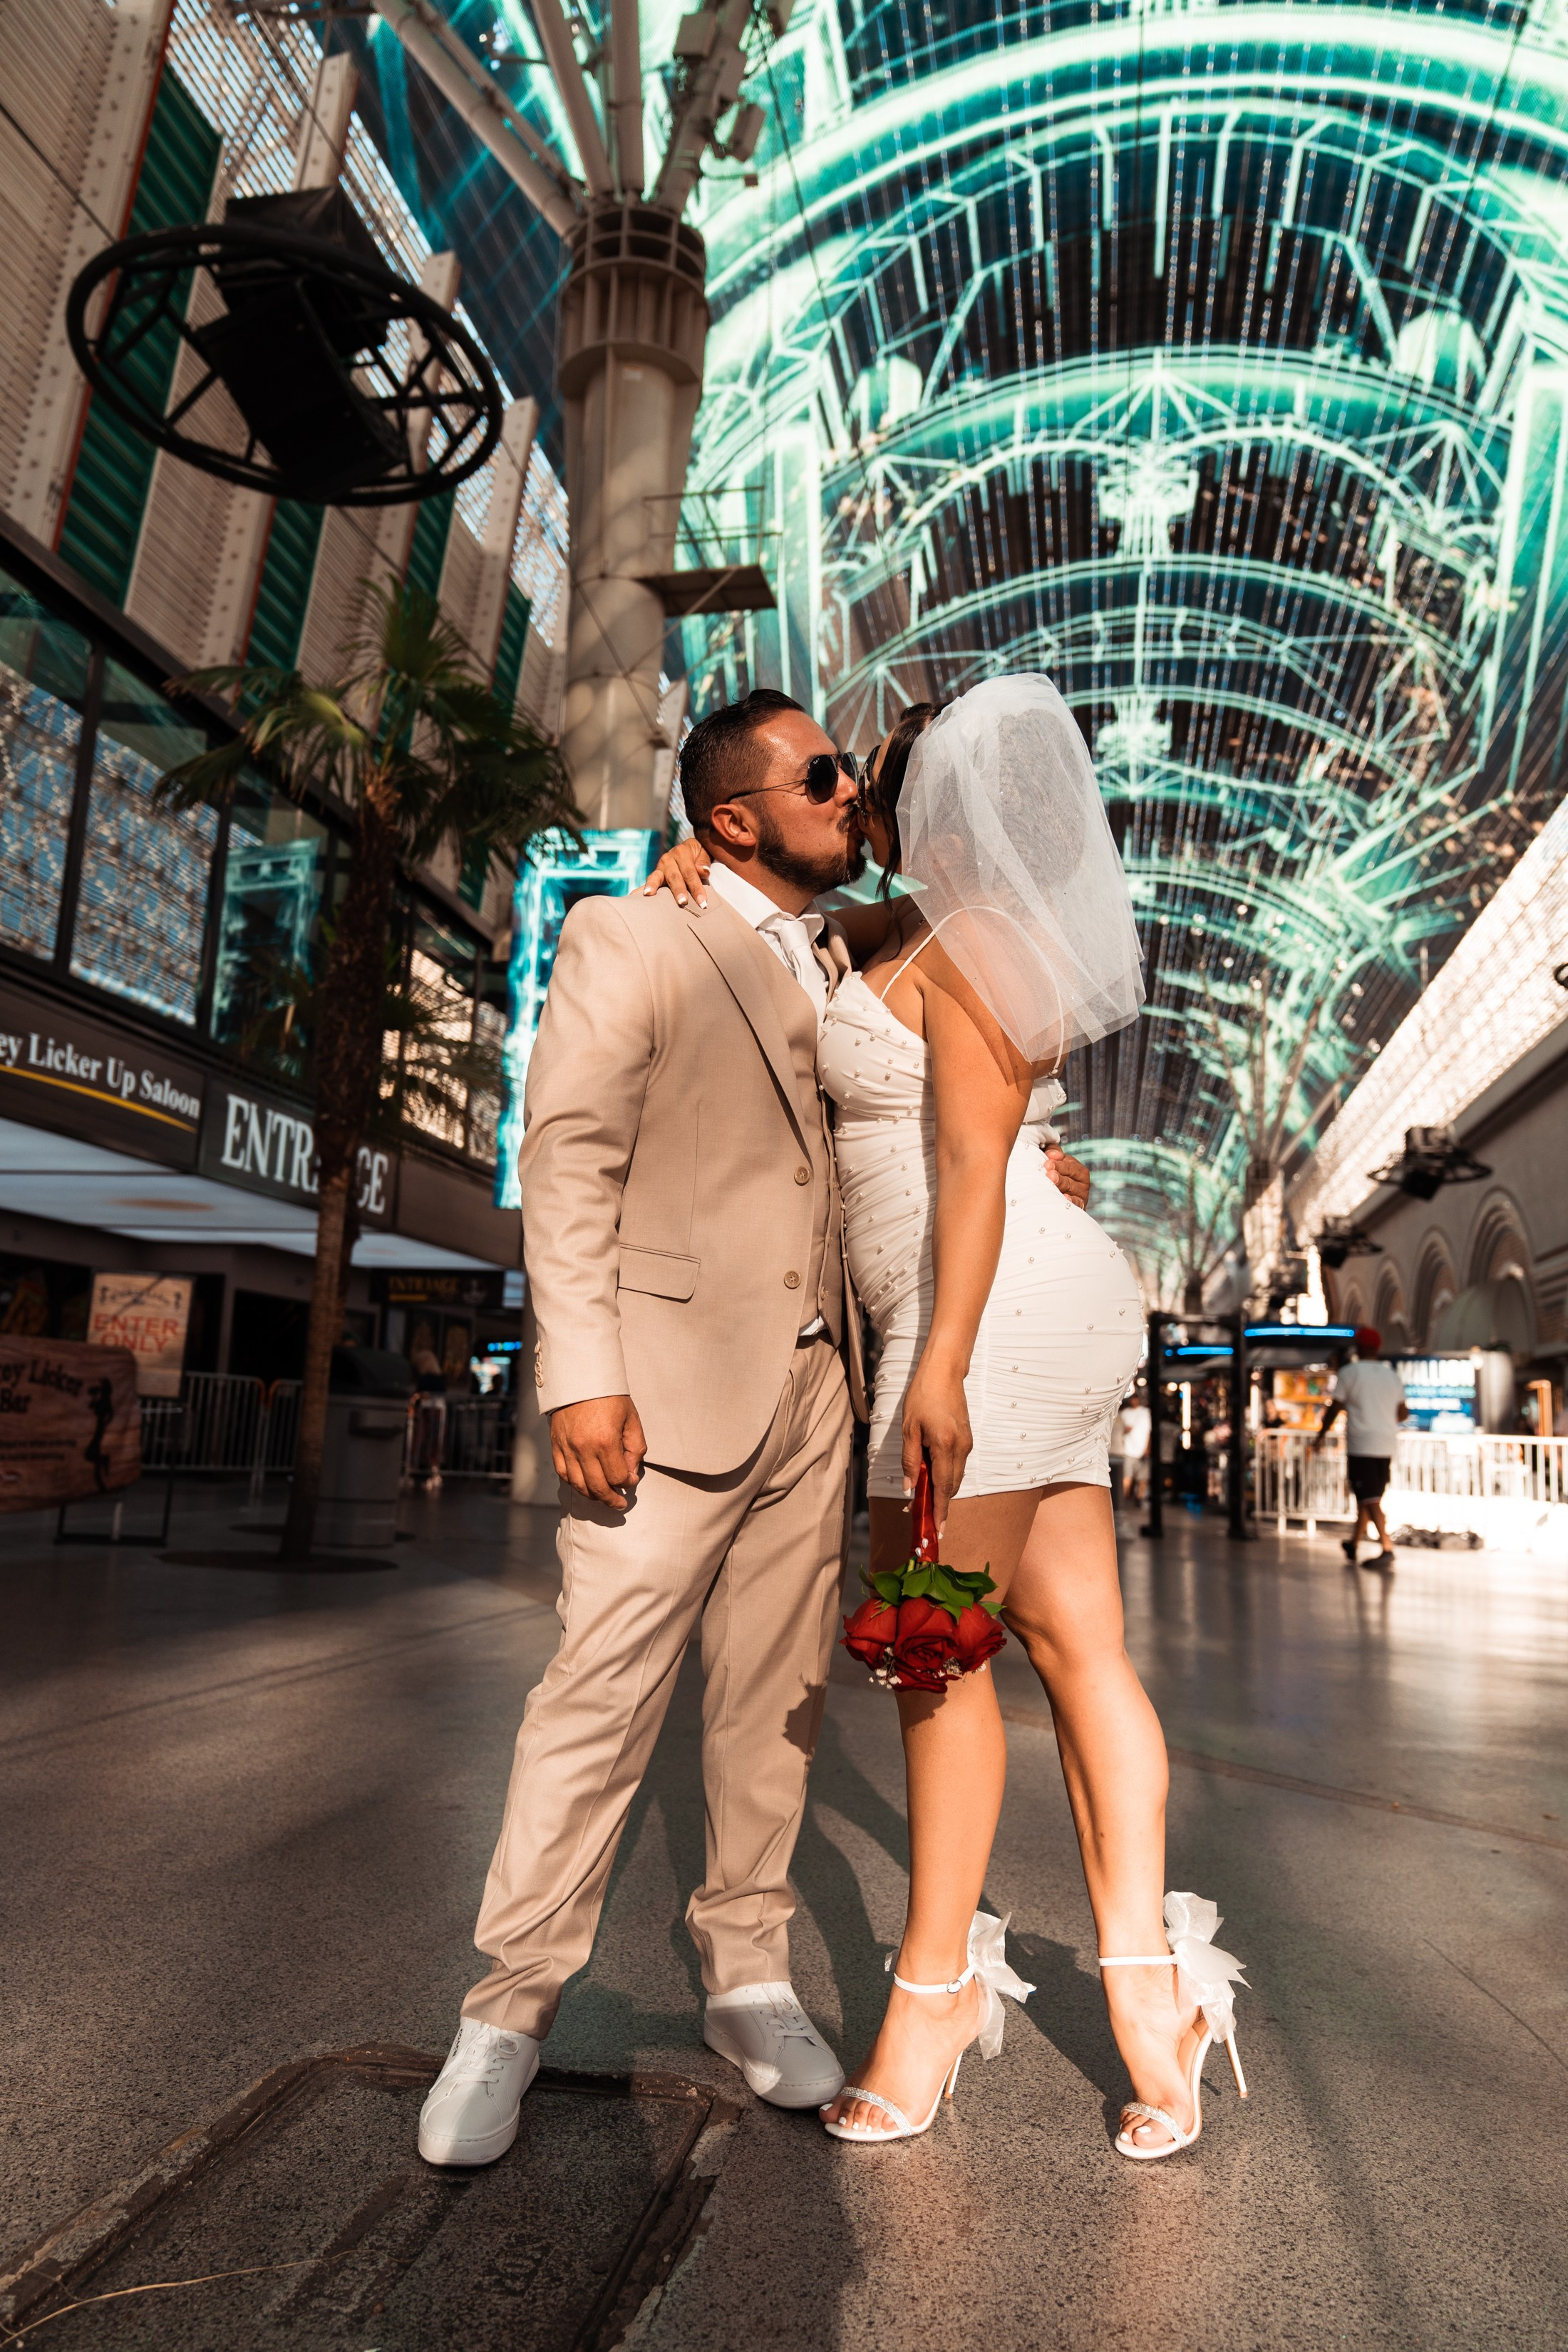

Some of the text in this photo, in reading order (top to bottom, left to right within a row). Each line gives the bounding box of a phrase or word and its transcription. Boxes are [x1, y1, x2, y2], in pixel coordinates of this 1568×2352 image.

[28, 1032, 102, 1082] Licker
[107, 1055, 136, 1099] Up
[139, 1069, 201, 1120] Saloon
[221, 1093, 389, 1215] ENTRCE
[93, 1314, 179, 1336] ENTER
[100, 1331, 169, 1353] ONLY
[0, 1363, 25, 1388] ey
